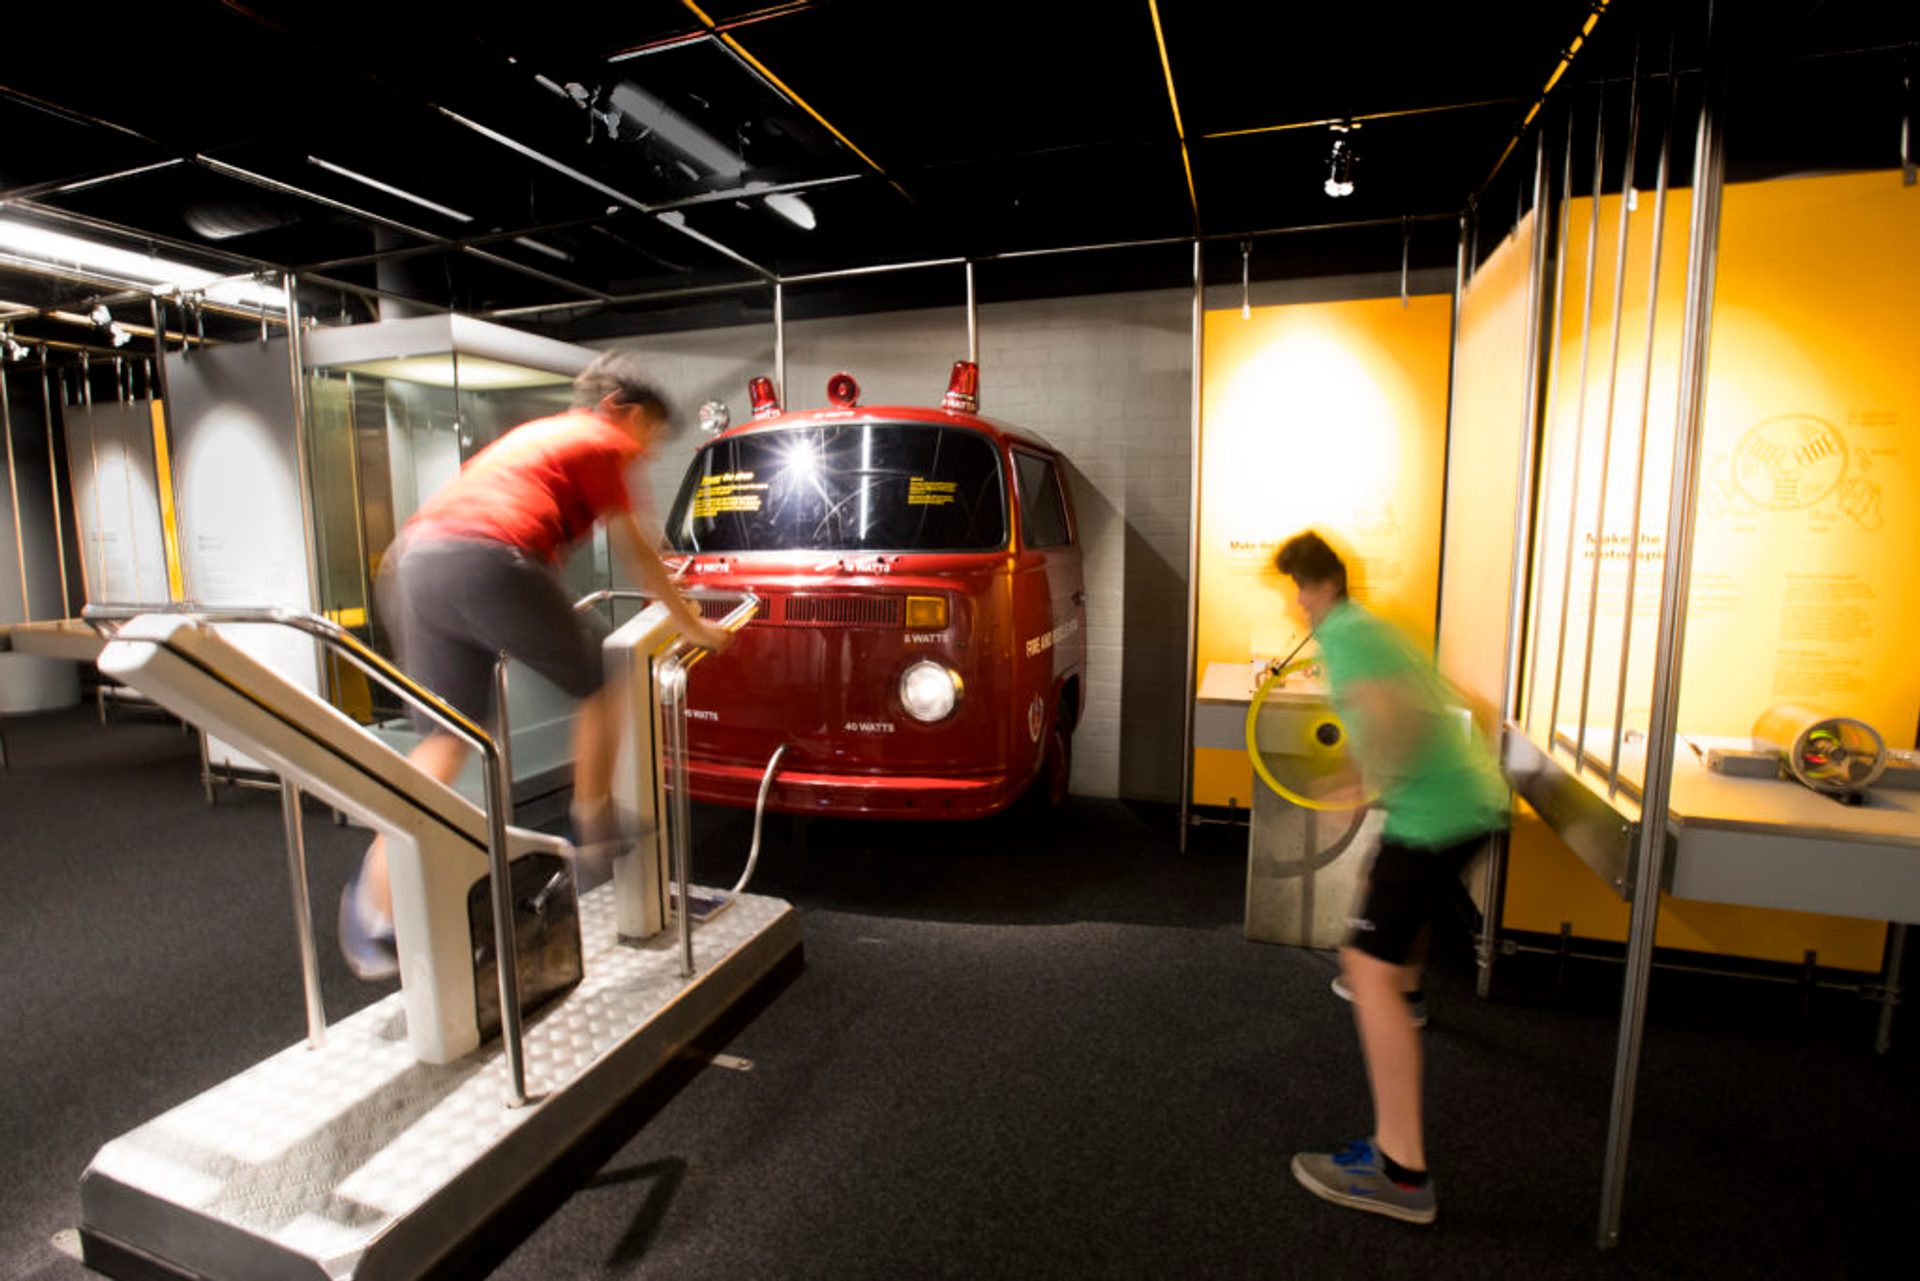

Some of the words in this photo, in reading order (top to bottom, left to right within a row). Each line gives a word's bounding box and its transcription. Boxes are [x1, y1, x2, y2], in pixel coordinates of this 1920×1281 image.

[911, 633, 950, 644] WATTS
[693, 709, 719, 721] WATTS
[859, 722, 895, 733] WATTS
